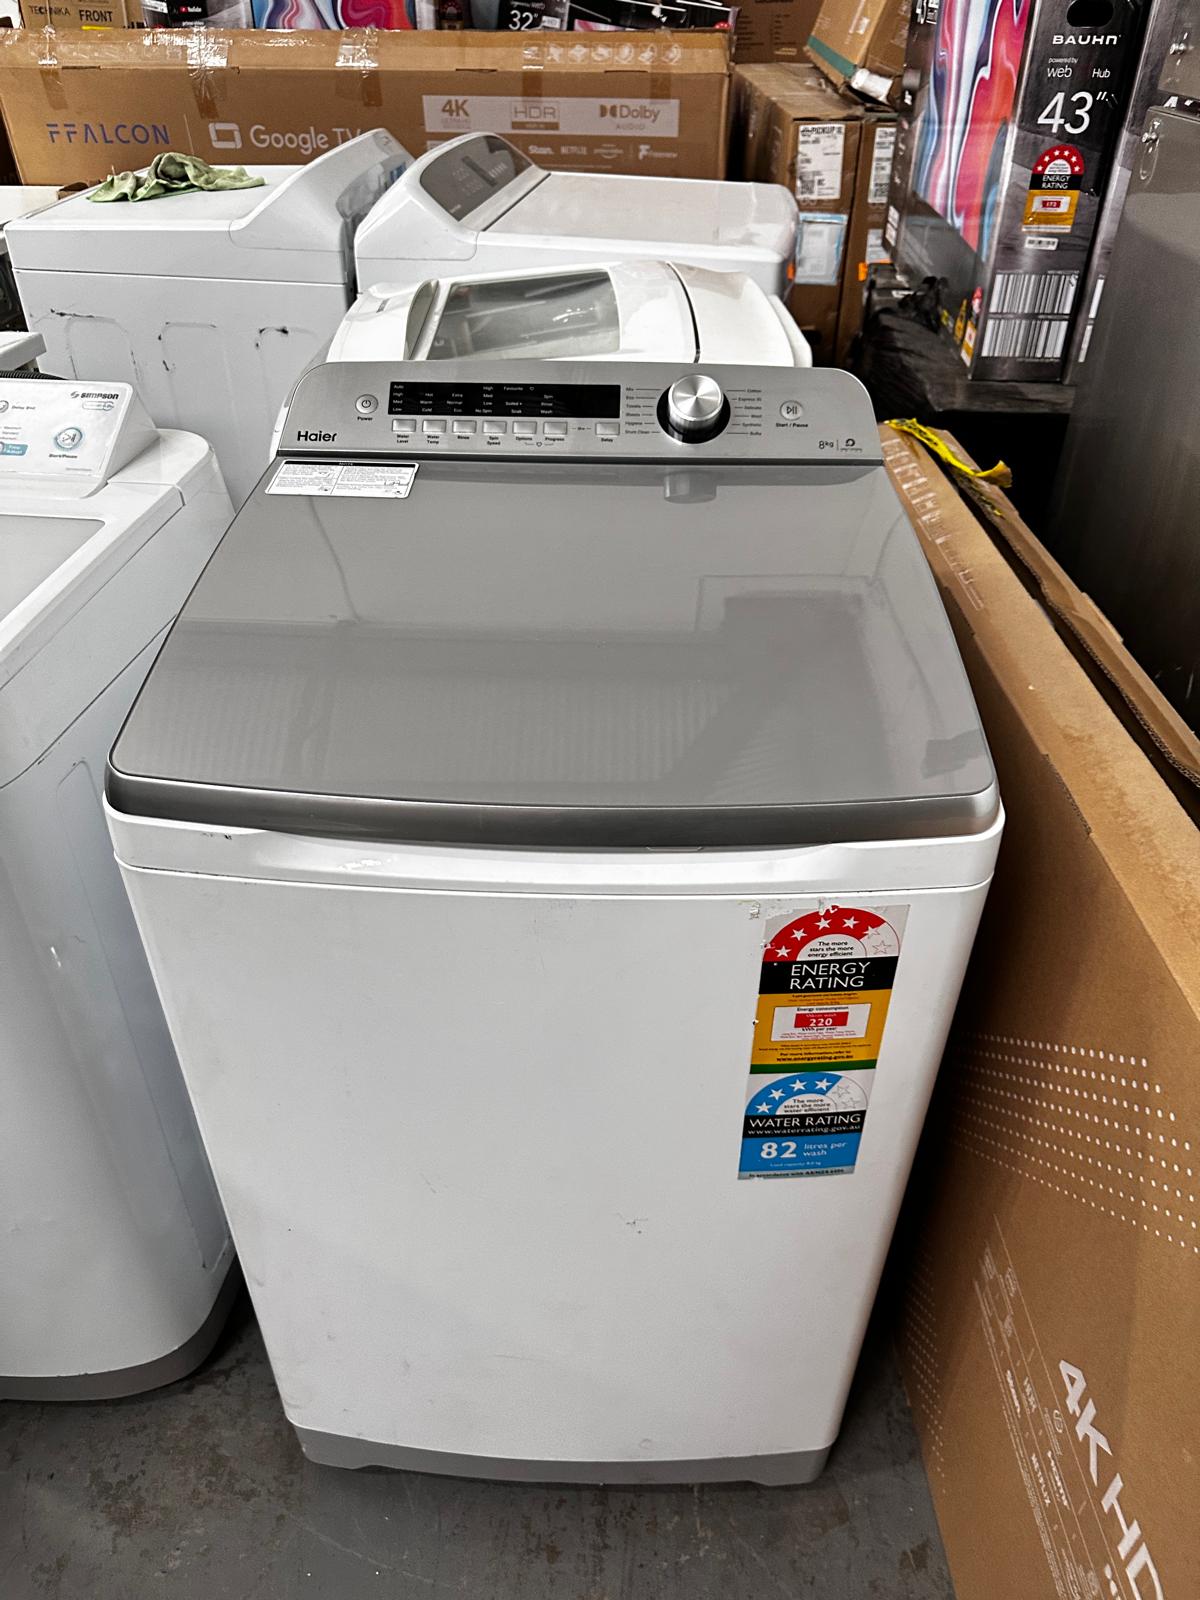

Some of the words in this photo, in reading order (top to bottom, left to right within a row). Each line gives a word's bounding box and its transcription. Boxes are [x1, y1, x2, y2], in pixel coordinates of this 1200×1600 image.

[79, 9, 113, 22] FRONT
[1047, 65, 1073, 78] web
[1091, 68, 1111, 78] Hub
[441, 98, 470, 118] 4K
[513, 105, 556, 119] HDR
[618, 104, 661, 123] Dolby
[1036, 91, 1108, 135] 43"
[46, 123, 170, 145] FFALCON
[249, 124, 329, 155] Google
[1042, 174, 1071, 182] ENERGY
[80, 392, 119, 400] SIMPSON
[296, 430, 338, 443] Haier
[818, 440, 834, 450] 8kg
[791, 961, 871, 977] ENERGY
[789, 976, 865, 991] RATING
[809, 1018, 833, 1027] 220
[749, 1117, 801, 1129] WATER
[805, 1113, 861, 1127] RATING
[747, 1124, 861, 1136] www.waterrating.gov.au
[760, 1141, 797, 1159] 82
[803, 1142, 828, 1150] litres
[830, 1141, 847, 1150] per
[802, 1149, 827, 1157] wash
[1058, 1358, 1113, 1488] 4K
[1031, 1453, 1052, 1507] NETFLIX
